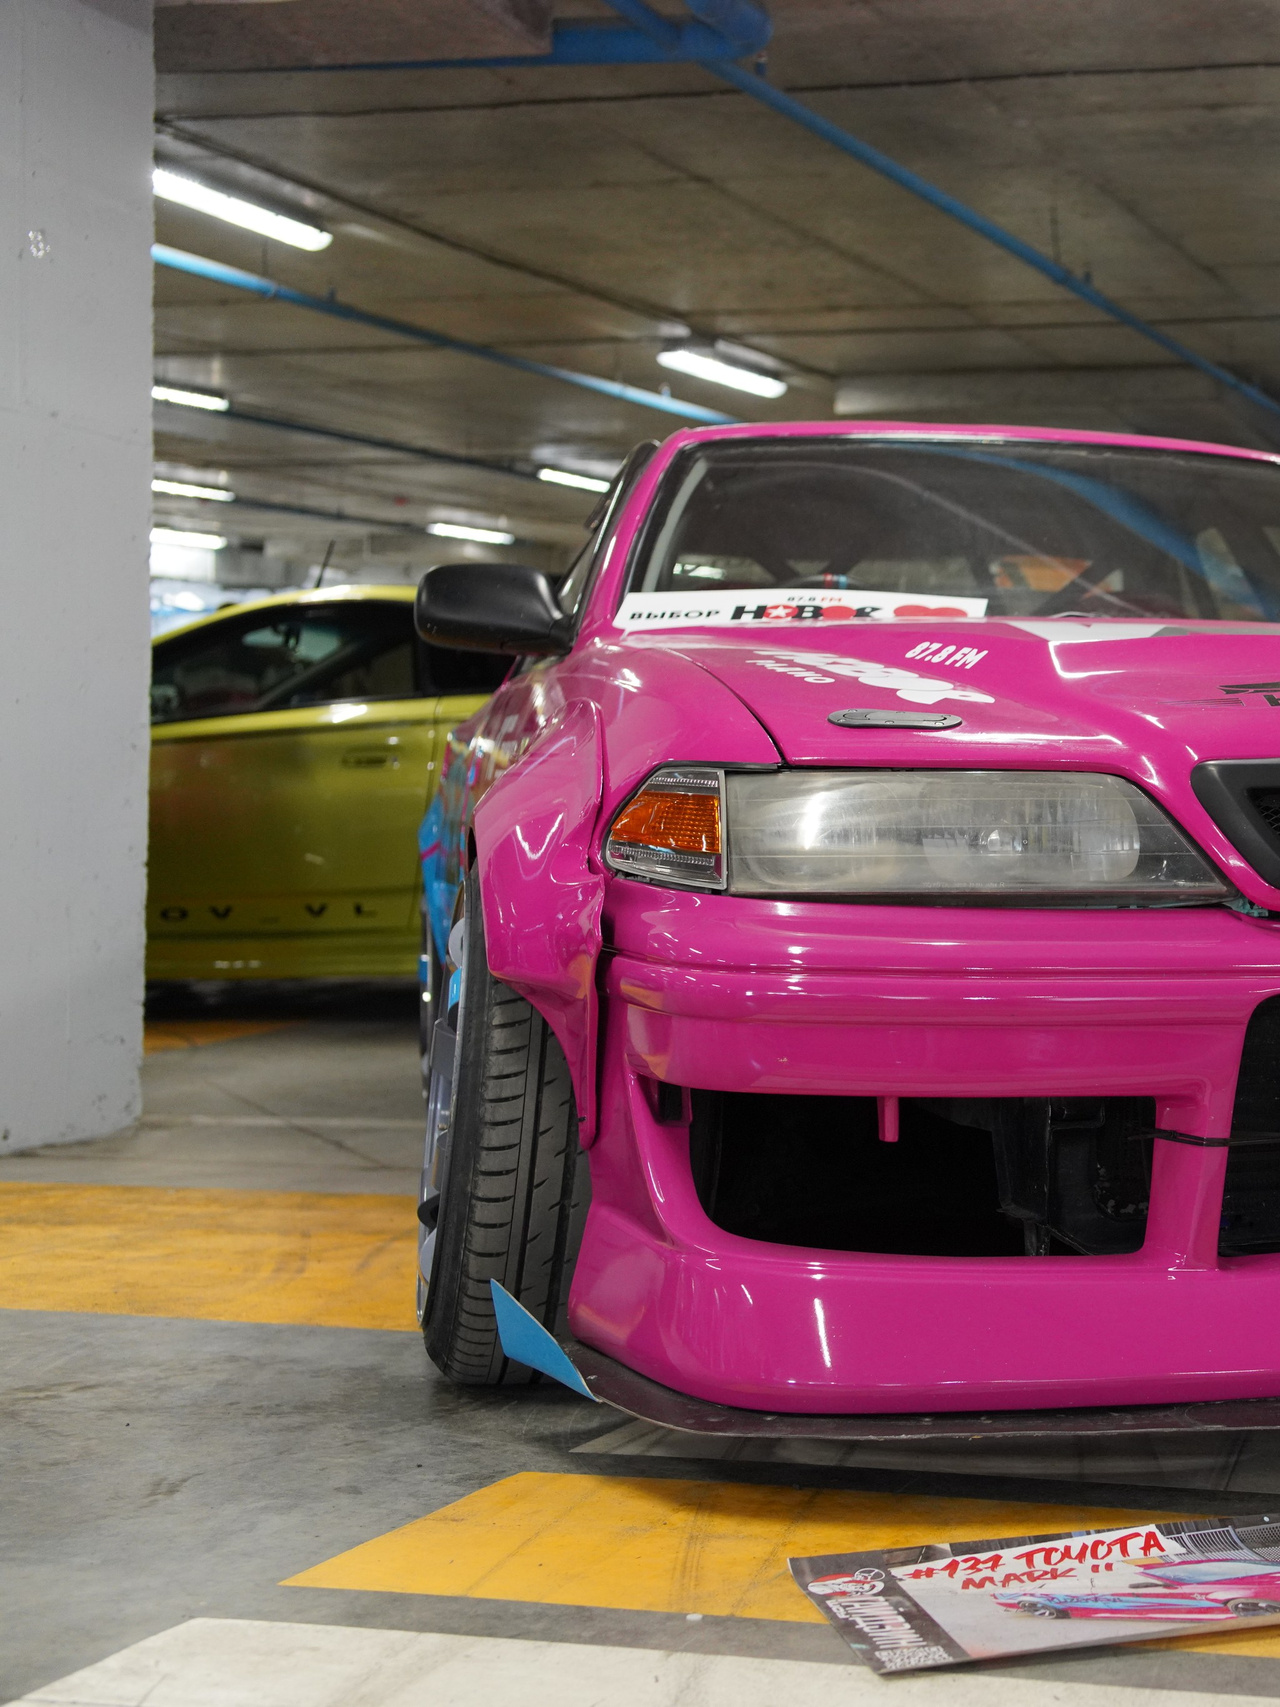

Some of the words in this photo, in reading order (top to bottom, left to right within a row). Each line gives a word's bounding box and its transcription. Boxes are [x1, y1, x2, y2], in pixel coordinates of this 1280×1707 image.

[630, 609, 721, 621] ВЫБОР
[905, 641, 956, 664] 87.8
[944, 647, 989, 670] FM
[906, 1553, 1004, 1581] #137
[1014, 1530, 1166, 1570] TOYOTA
[960, 1566, 1078, 1591] MARK
